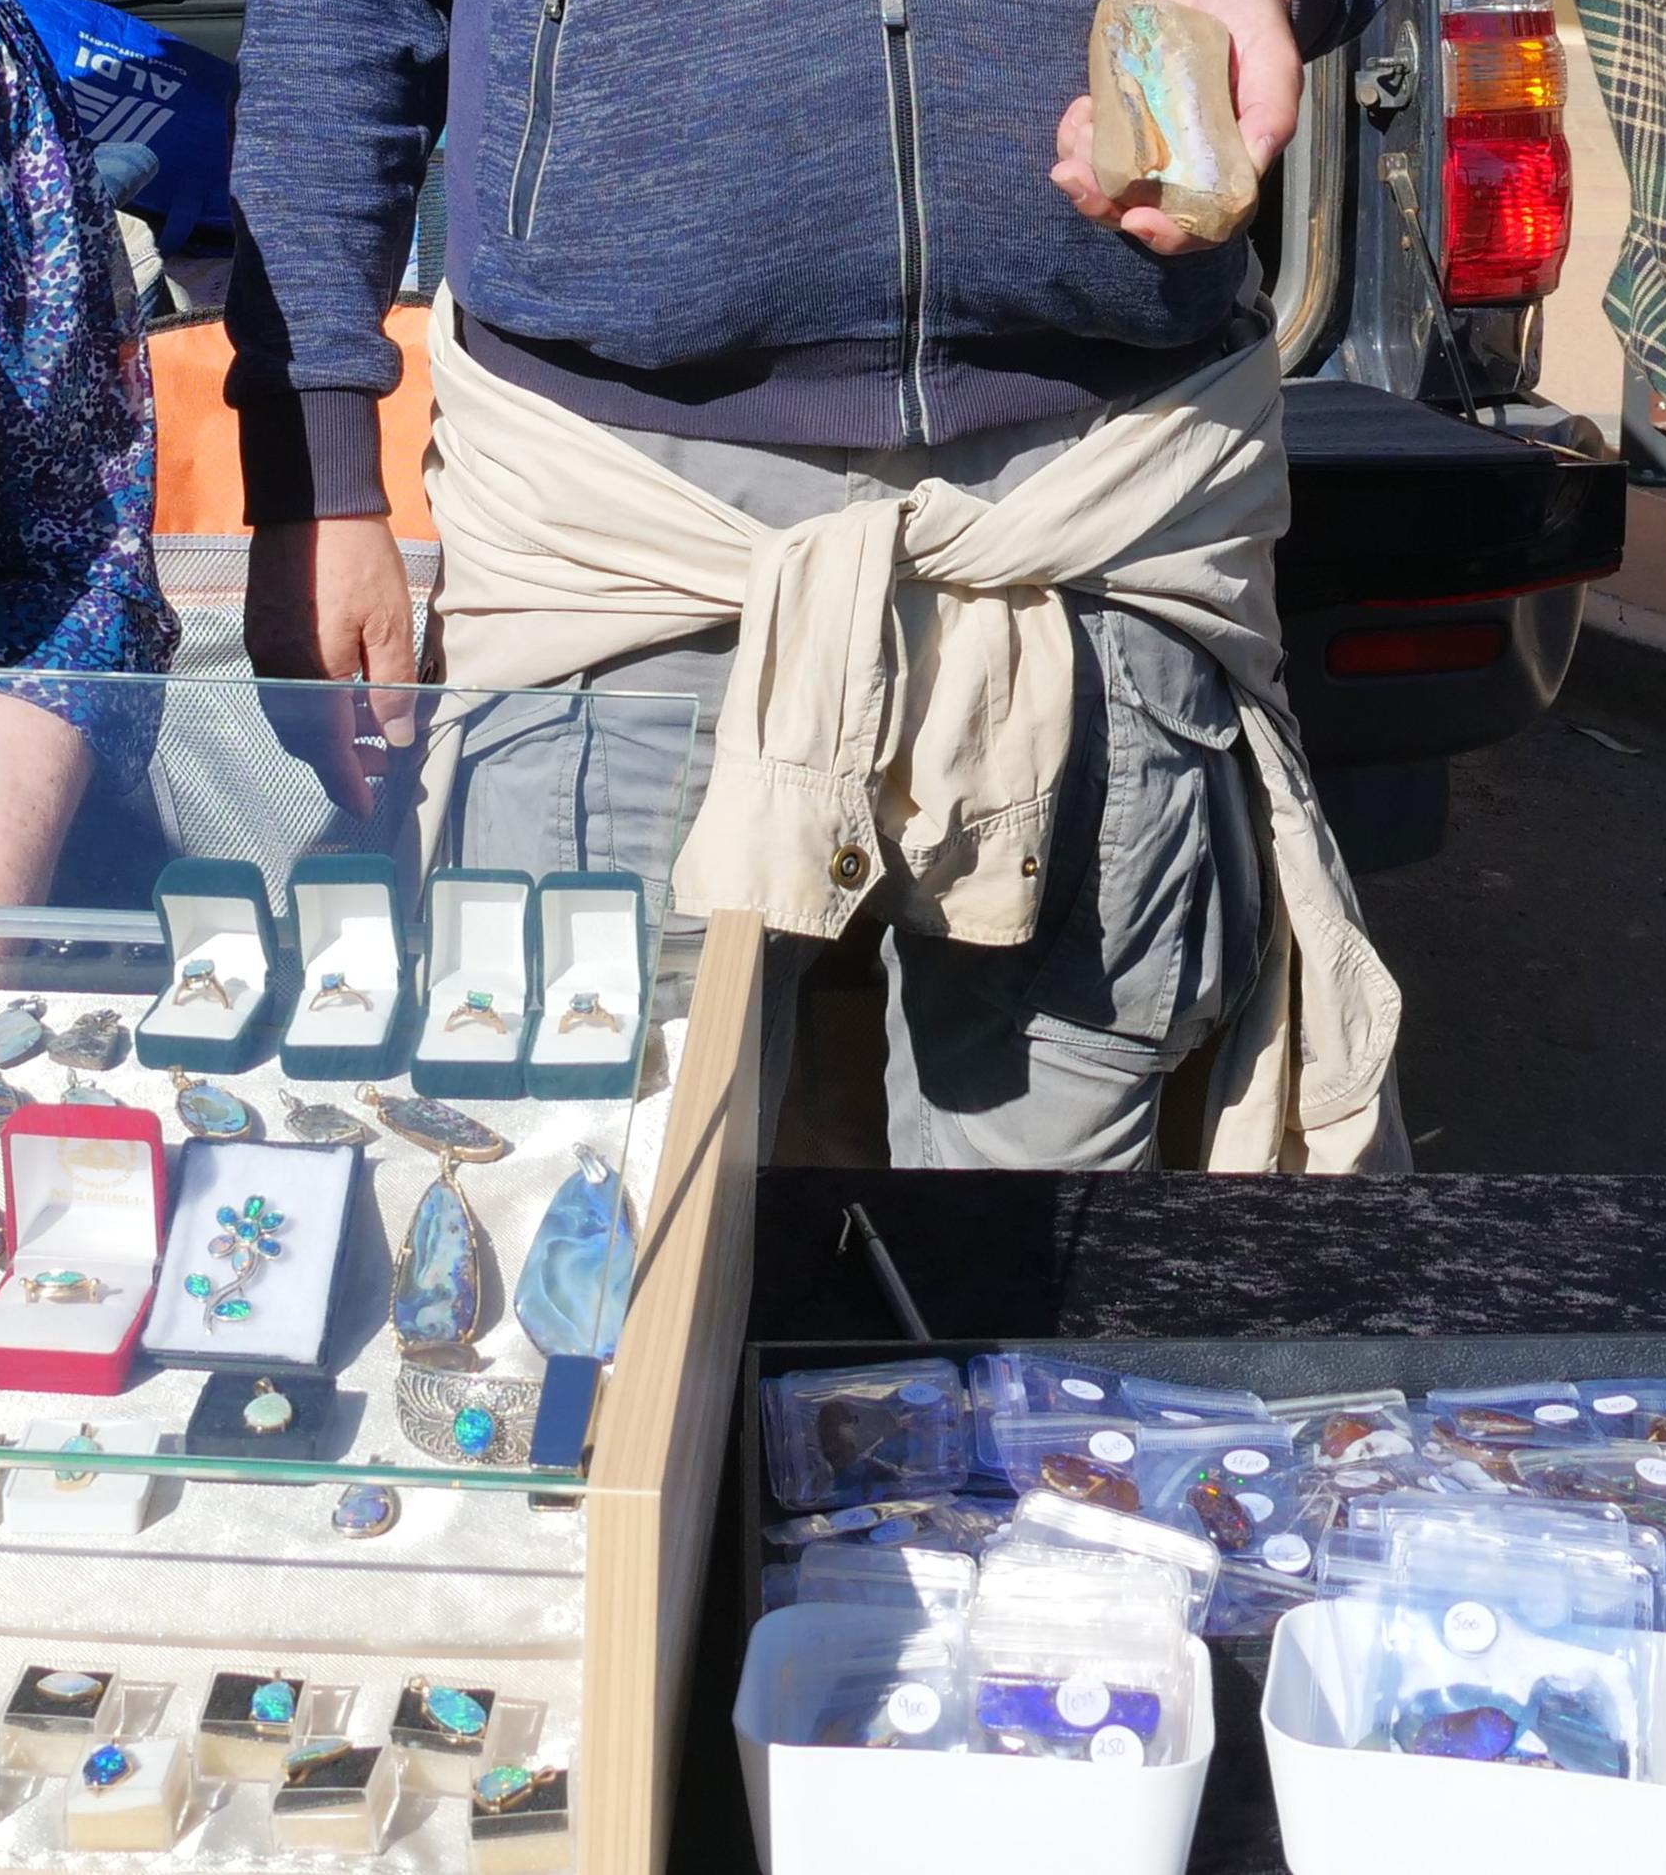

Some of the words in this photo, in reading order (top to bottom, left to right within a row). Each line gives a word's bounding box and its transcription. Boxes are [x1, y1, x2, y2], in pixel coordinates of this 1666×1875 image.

[75, 45, 182, 101] ALDI
[897, 1693, 928, 1719] 900
[1096, 1737, 1127, 1757] 250
